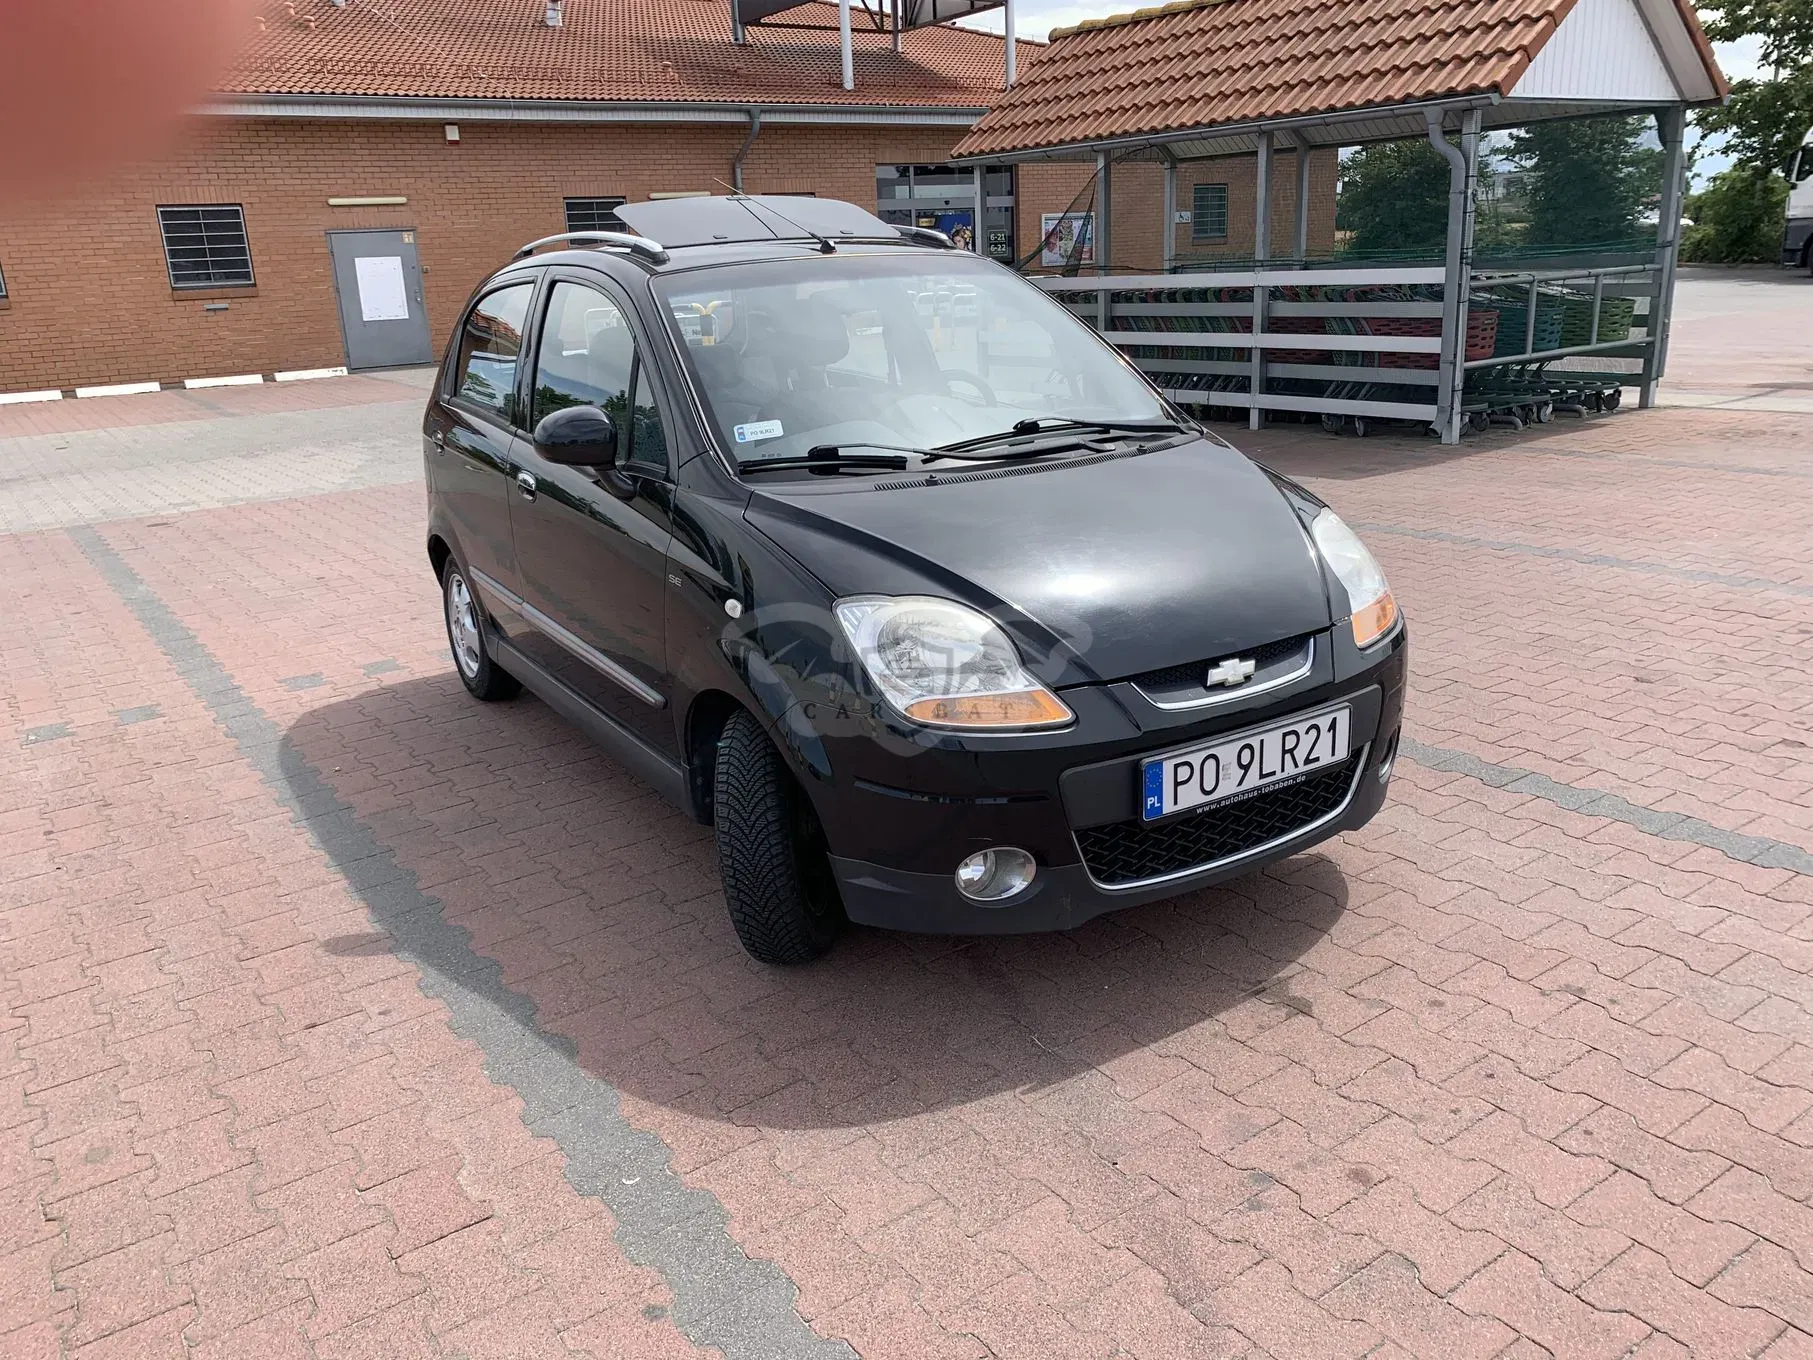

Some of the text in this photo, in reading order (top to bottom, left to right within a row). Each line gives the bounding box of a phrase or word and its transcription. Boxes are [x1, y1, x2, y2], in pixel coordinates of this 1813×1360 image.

[668, 574, 682, 587] SE
[1173, 716, 1338, 806] PO 9LR21
[1147, 796, 1161, 810] PL
[1195, 774, 1307, 814] www.autohaus-tobaben.de
